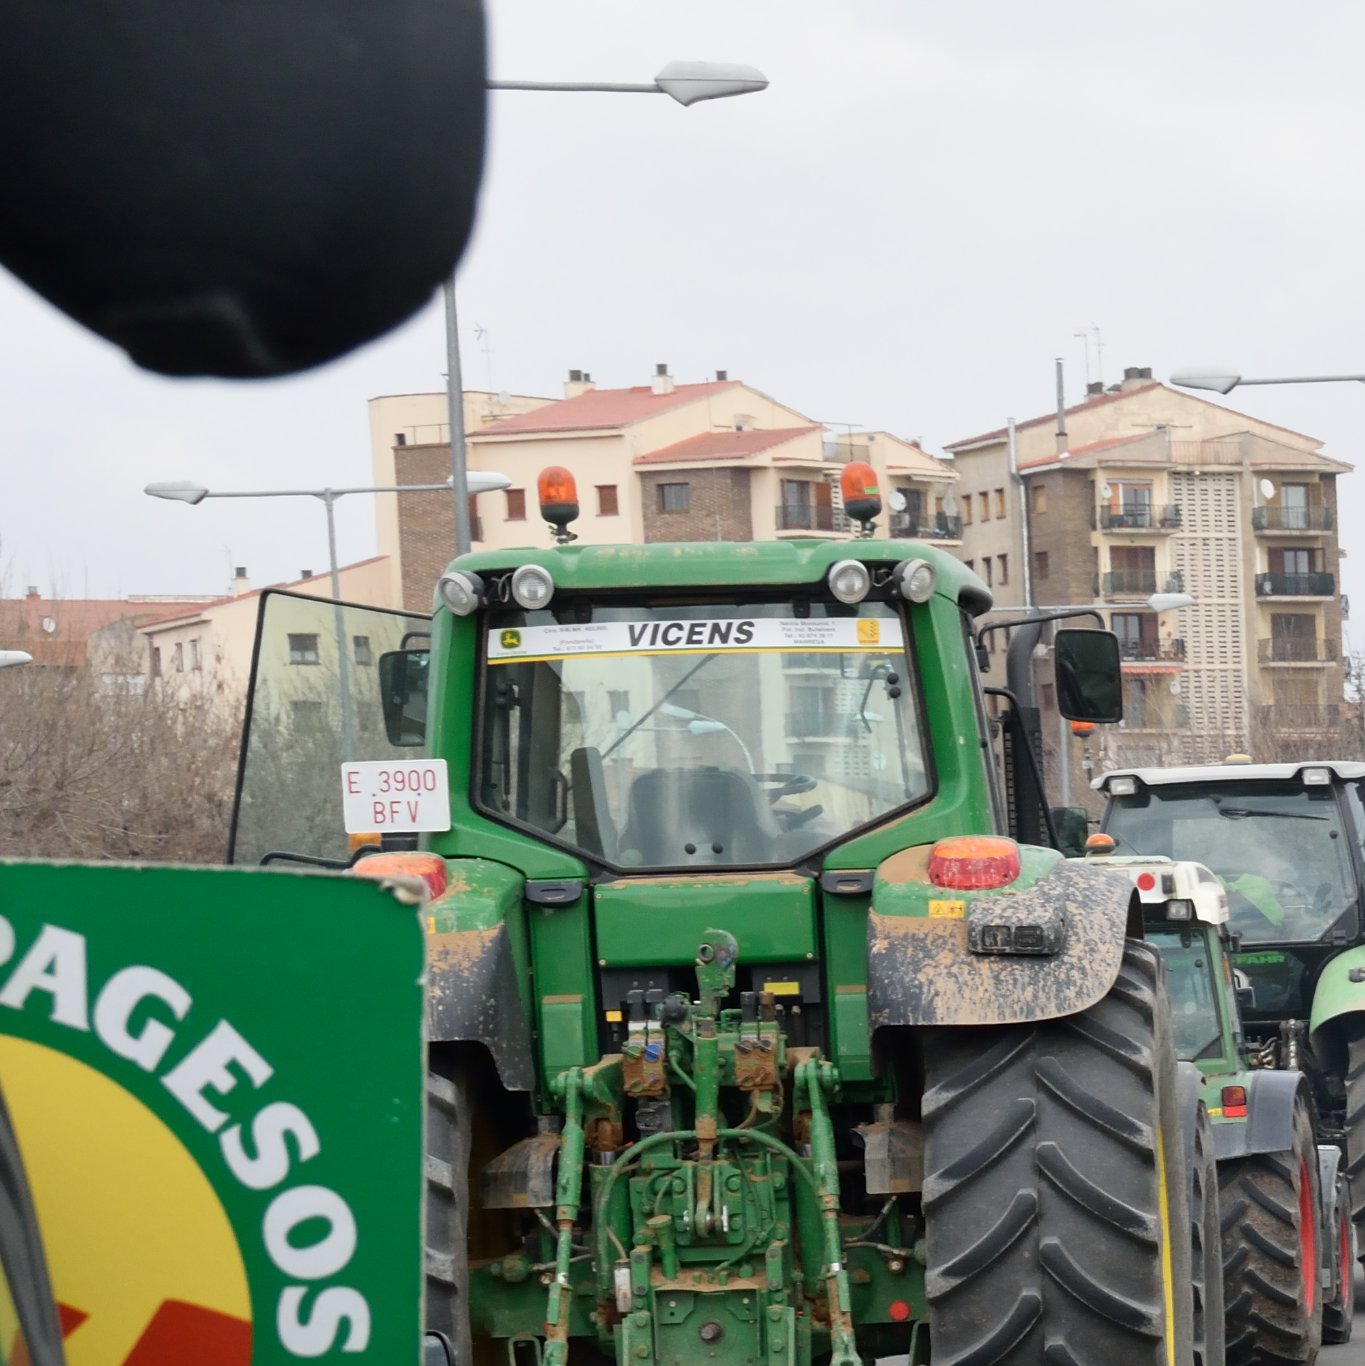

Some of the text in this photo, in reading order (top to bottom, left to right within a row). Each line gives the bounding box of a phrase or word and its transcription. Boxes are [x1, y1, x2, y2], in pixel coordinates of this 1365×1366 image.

[627, 620, 756, 647] VICENS
[347, 769, 437, 794] E 3900
[373, 800, 419, 825] BFV
[0, 914, 371, 1359] AGESOS
